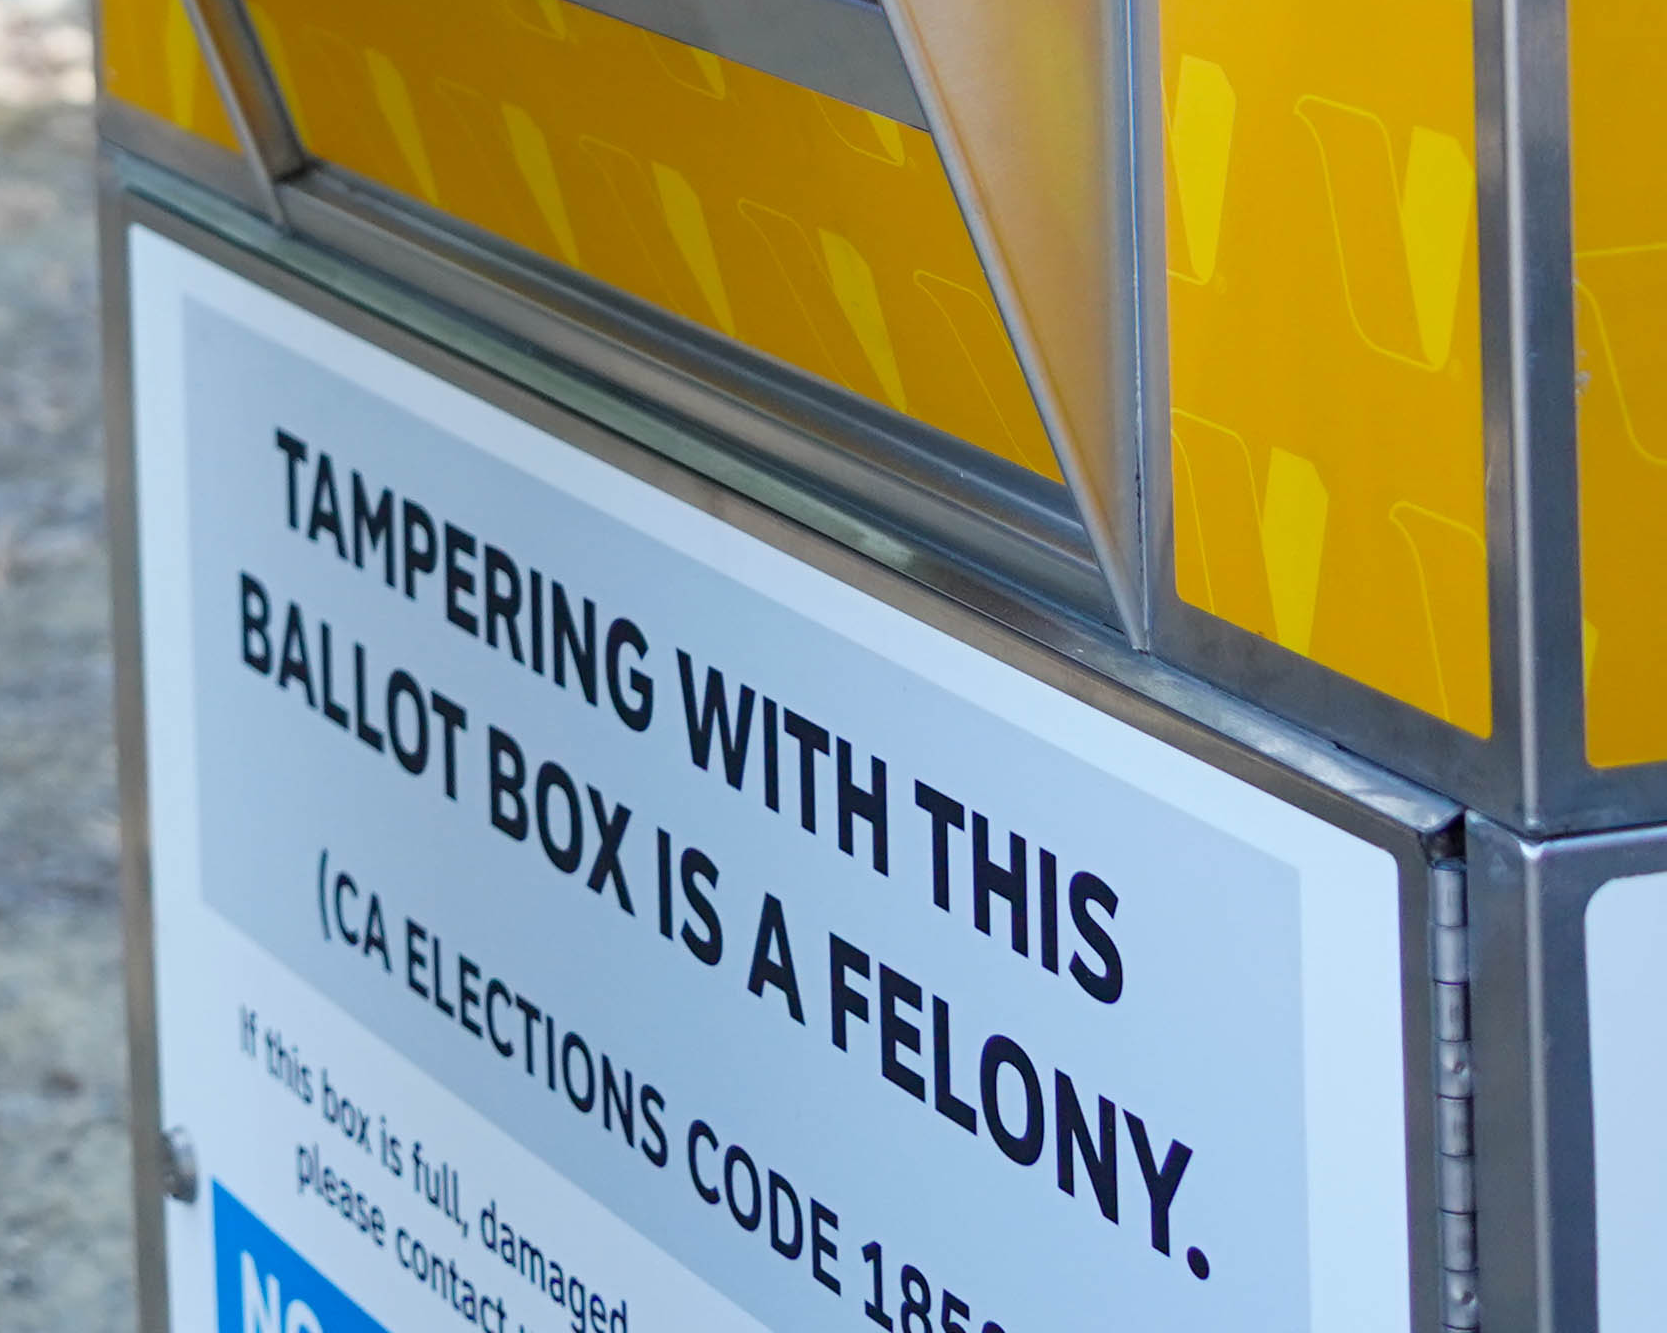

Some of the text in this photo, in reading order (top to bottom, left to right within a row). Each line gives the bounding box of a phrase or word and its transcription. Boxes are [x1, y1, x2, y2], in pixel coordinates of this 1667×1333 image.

[239, 570, 1211, 1281] BALLOT BOX IS A FELONY.
[275, 426, 1124, 1005] TAMPERING WITH THIS
[239, 1004, 628, 1333] If this box is full, damaged
[296, 1144, 507, 1333] please contact
[317, 848, 1006, 1333] (CA ELECTIONS CODE 18
